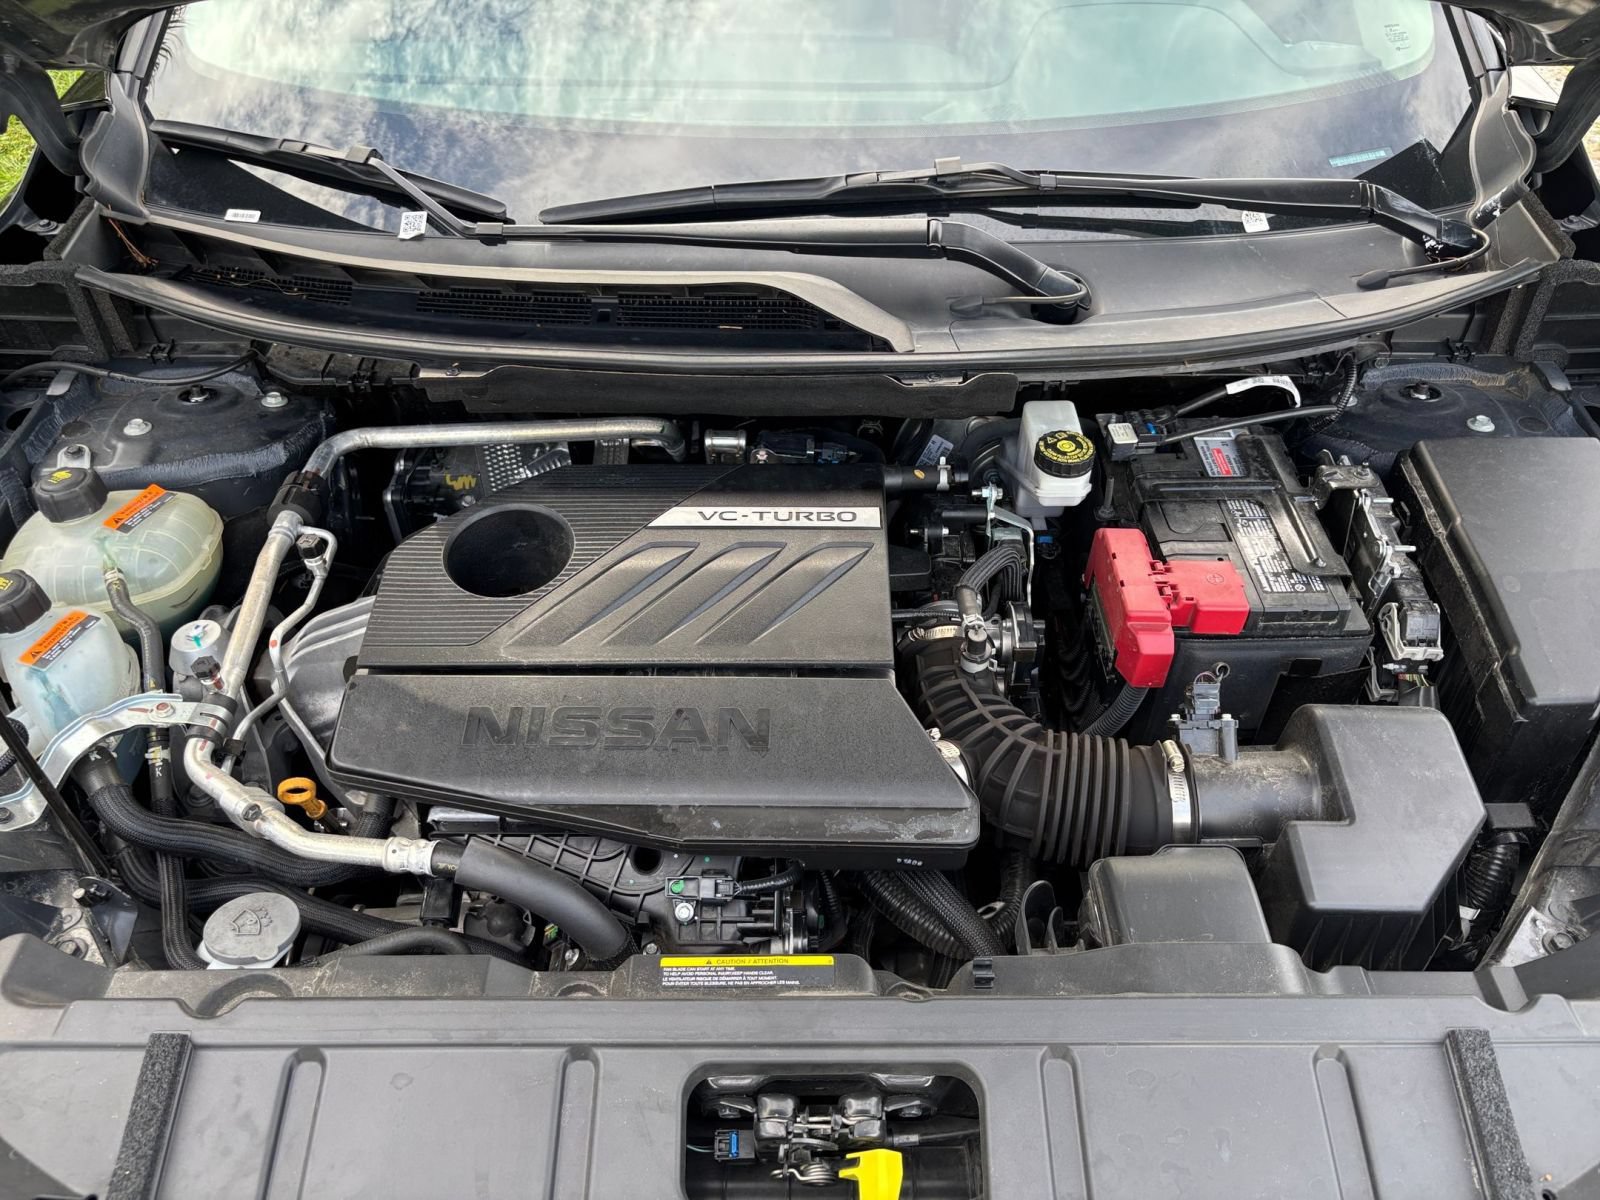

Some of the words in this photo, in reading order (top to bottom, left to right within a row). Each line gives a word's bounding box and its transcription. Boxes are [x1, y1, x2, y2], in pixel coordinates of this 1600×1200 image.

[698, 511, 857, 522] VC-TURBO
[461, 706, 770, 750] NISSAN
[155, 767, 162, 777] K
